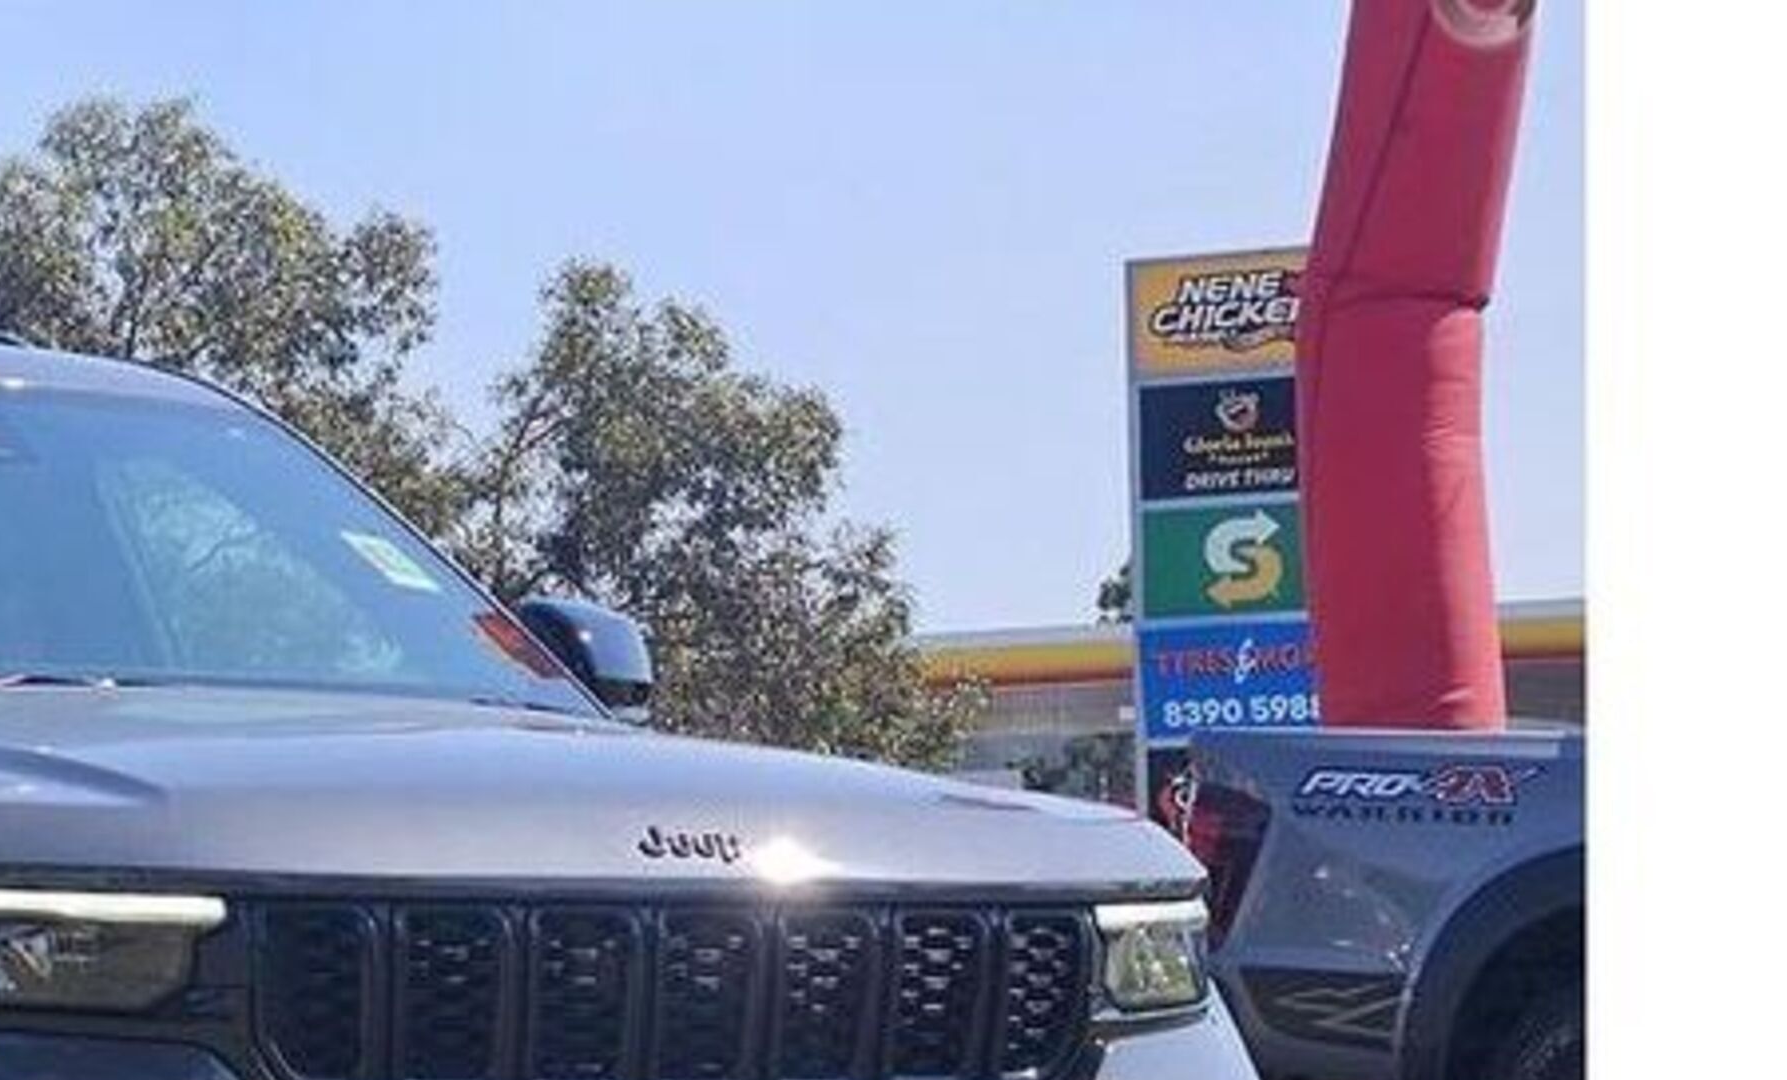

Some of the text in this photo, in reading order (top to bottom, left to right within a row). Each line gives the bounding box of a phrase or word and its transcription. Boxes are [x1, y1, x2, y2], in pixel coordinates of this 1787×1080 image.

[1178, 271, 1283, 304] NENE
[1186, 466, 1296, 490] DRIVE THRU
[1164, 697, 1244, 728] 8390
[637, 824, 741, 865] Jeep
